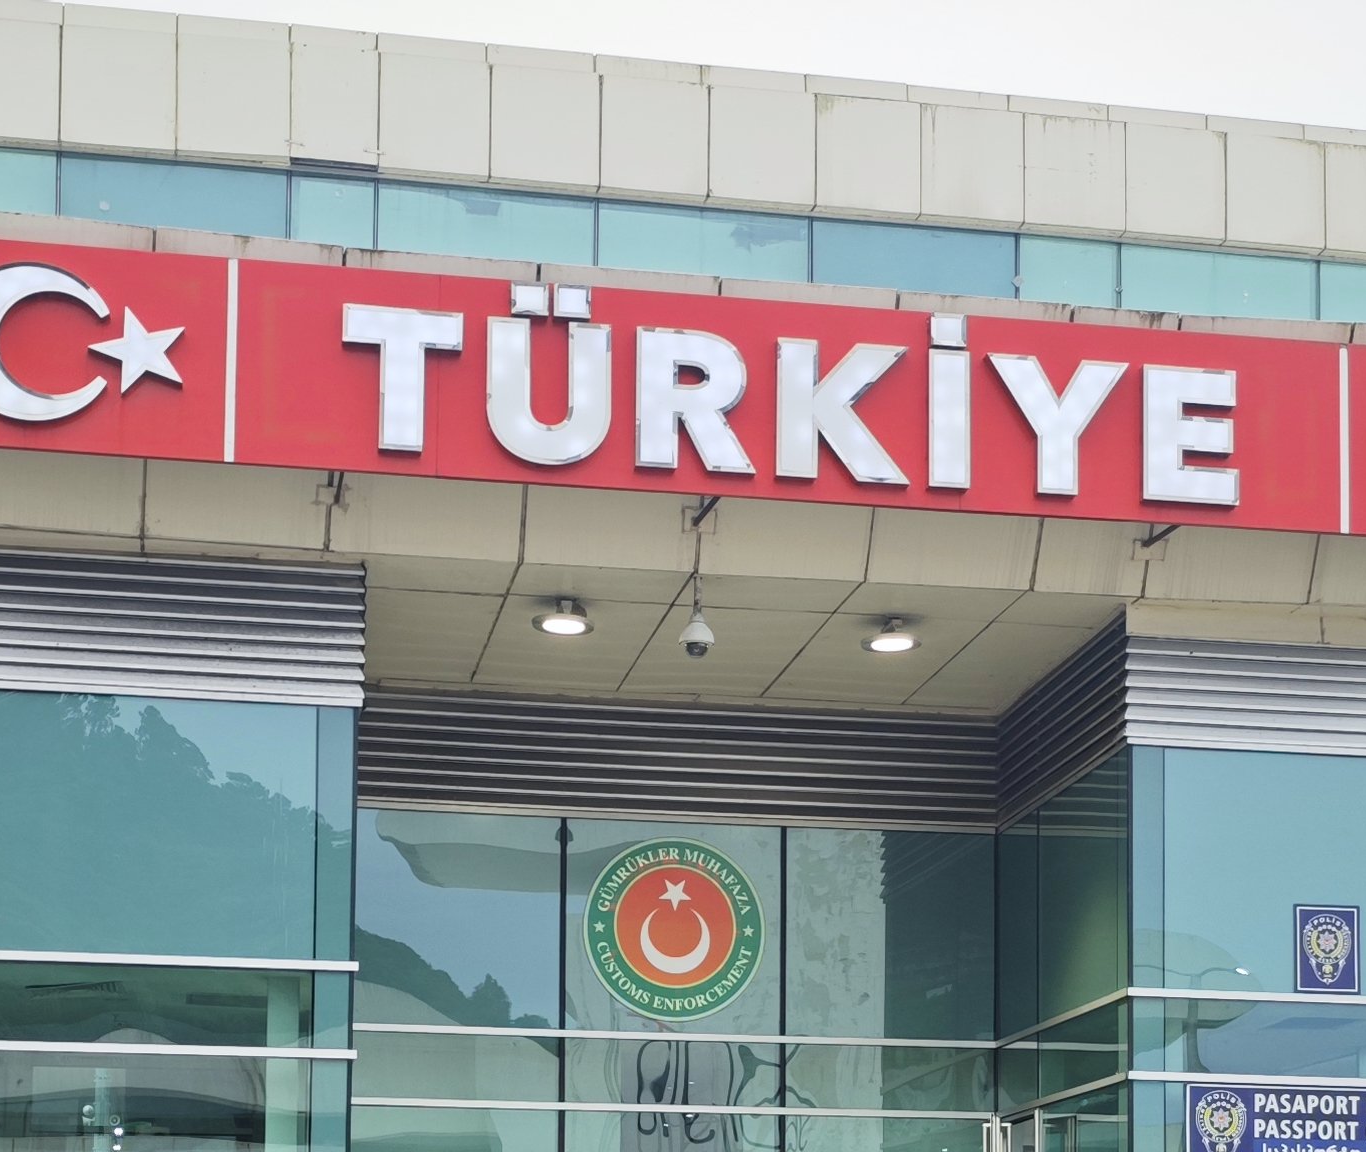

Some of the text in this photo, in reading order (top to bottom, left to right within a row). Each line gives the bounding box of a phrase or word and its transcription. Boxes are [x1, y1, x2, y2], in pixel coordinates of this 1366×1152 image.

[342, 281, 1240, 506] TÜRKİYE
[597, 847, 752, 916] GÜMRÜKLER MUHAFAZA
[596, 941, 752, 1011] CUSTOMS ENFORCEMENT
[1253, 1093, 1361, 1116] PASAPORT
[1253, 1118, 1360, 1141] PASSPORT
